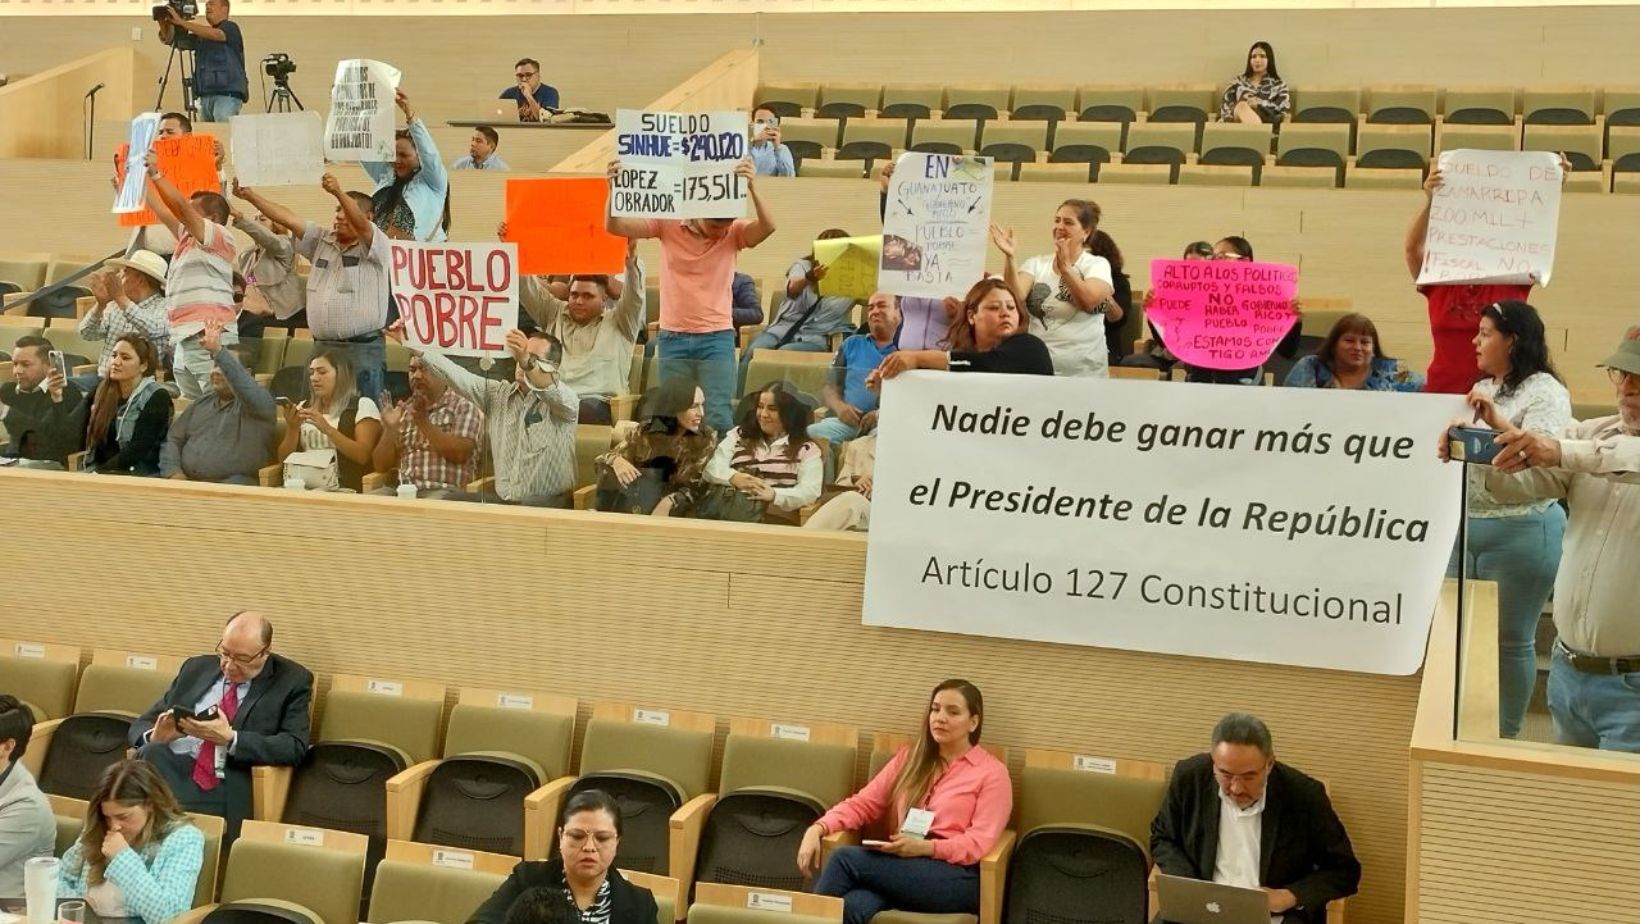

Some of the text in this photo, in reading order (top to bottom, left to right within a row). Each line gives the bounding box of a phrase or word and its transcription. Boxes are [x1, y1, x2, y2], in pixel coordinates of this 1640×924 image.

[641, 113, 710, 134] SUELDO
[925, 154, 950, 179] EN
[1529, 165, 1558, 181] DE
[614, 169, 658, 189] LOPEZ
[897, 181, 977, 201] GUANAJUATO
[615, 191, 675, 213] OBRADOR
[1473, 209, 1515, 227] MIL
[391, 246, 511, 292] PUEBLO
[925, 253, 940, 271] YA
[1164, 265, 1200, 280] ALTO
[1203, 265, 1213, 279] A
[1215, 267, 1239, 281] LOS
[1157, 280, 1282, 296] CORRUPTOS Y FALSOS
[1160, 298, 1192, 310] PUEDE
[1204, 305, 1239, 316] HABER
[1208, 293, 1234, 305] NO
[395, 292, 510, 351] POBRE
[1205, 318, 1247, 328] PUEBLO
[1255, 310, 1282, 320] RICO
[1194, 335, 1252, 349] ESTAMOS
[1209, 350, 1244, 360] TIGO
[932, 405, 1414, 463] Nadie debe ganar más que
[909, 478, 1429, 542] el Presidente de la República
[921, 556, 1402, 625] Artículo 127 Constitucional
